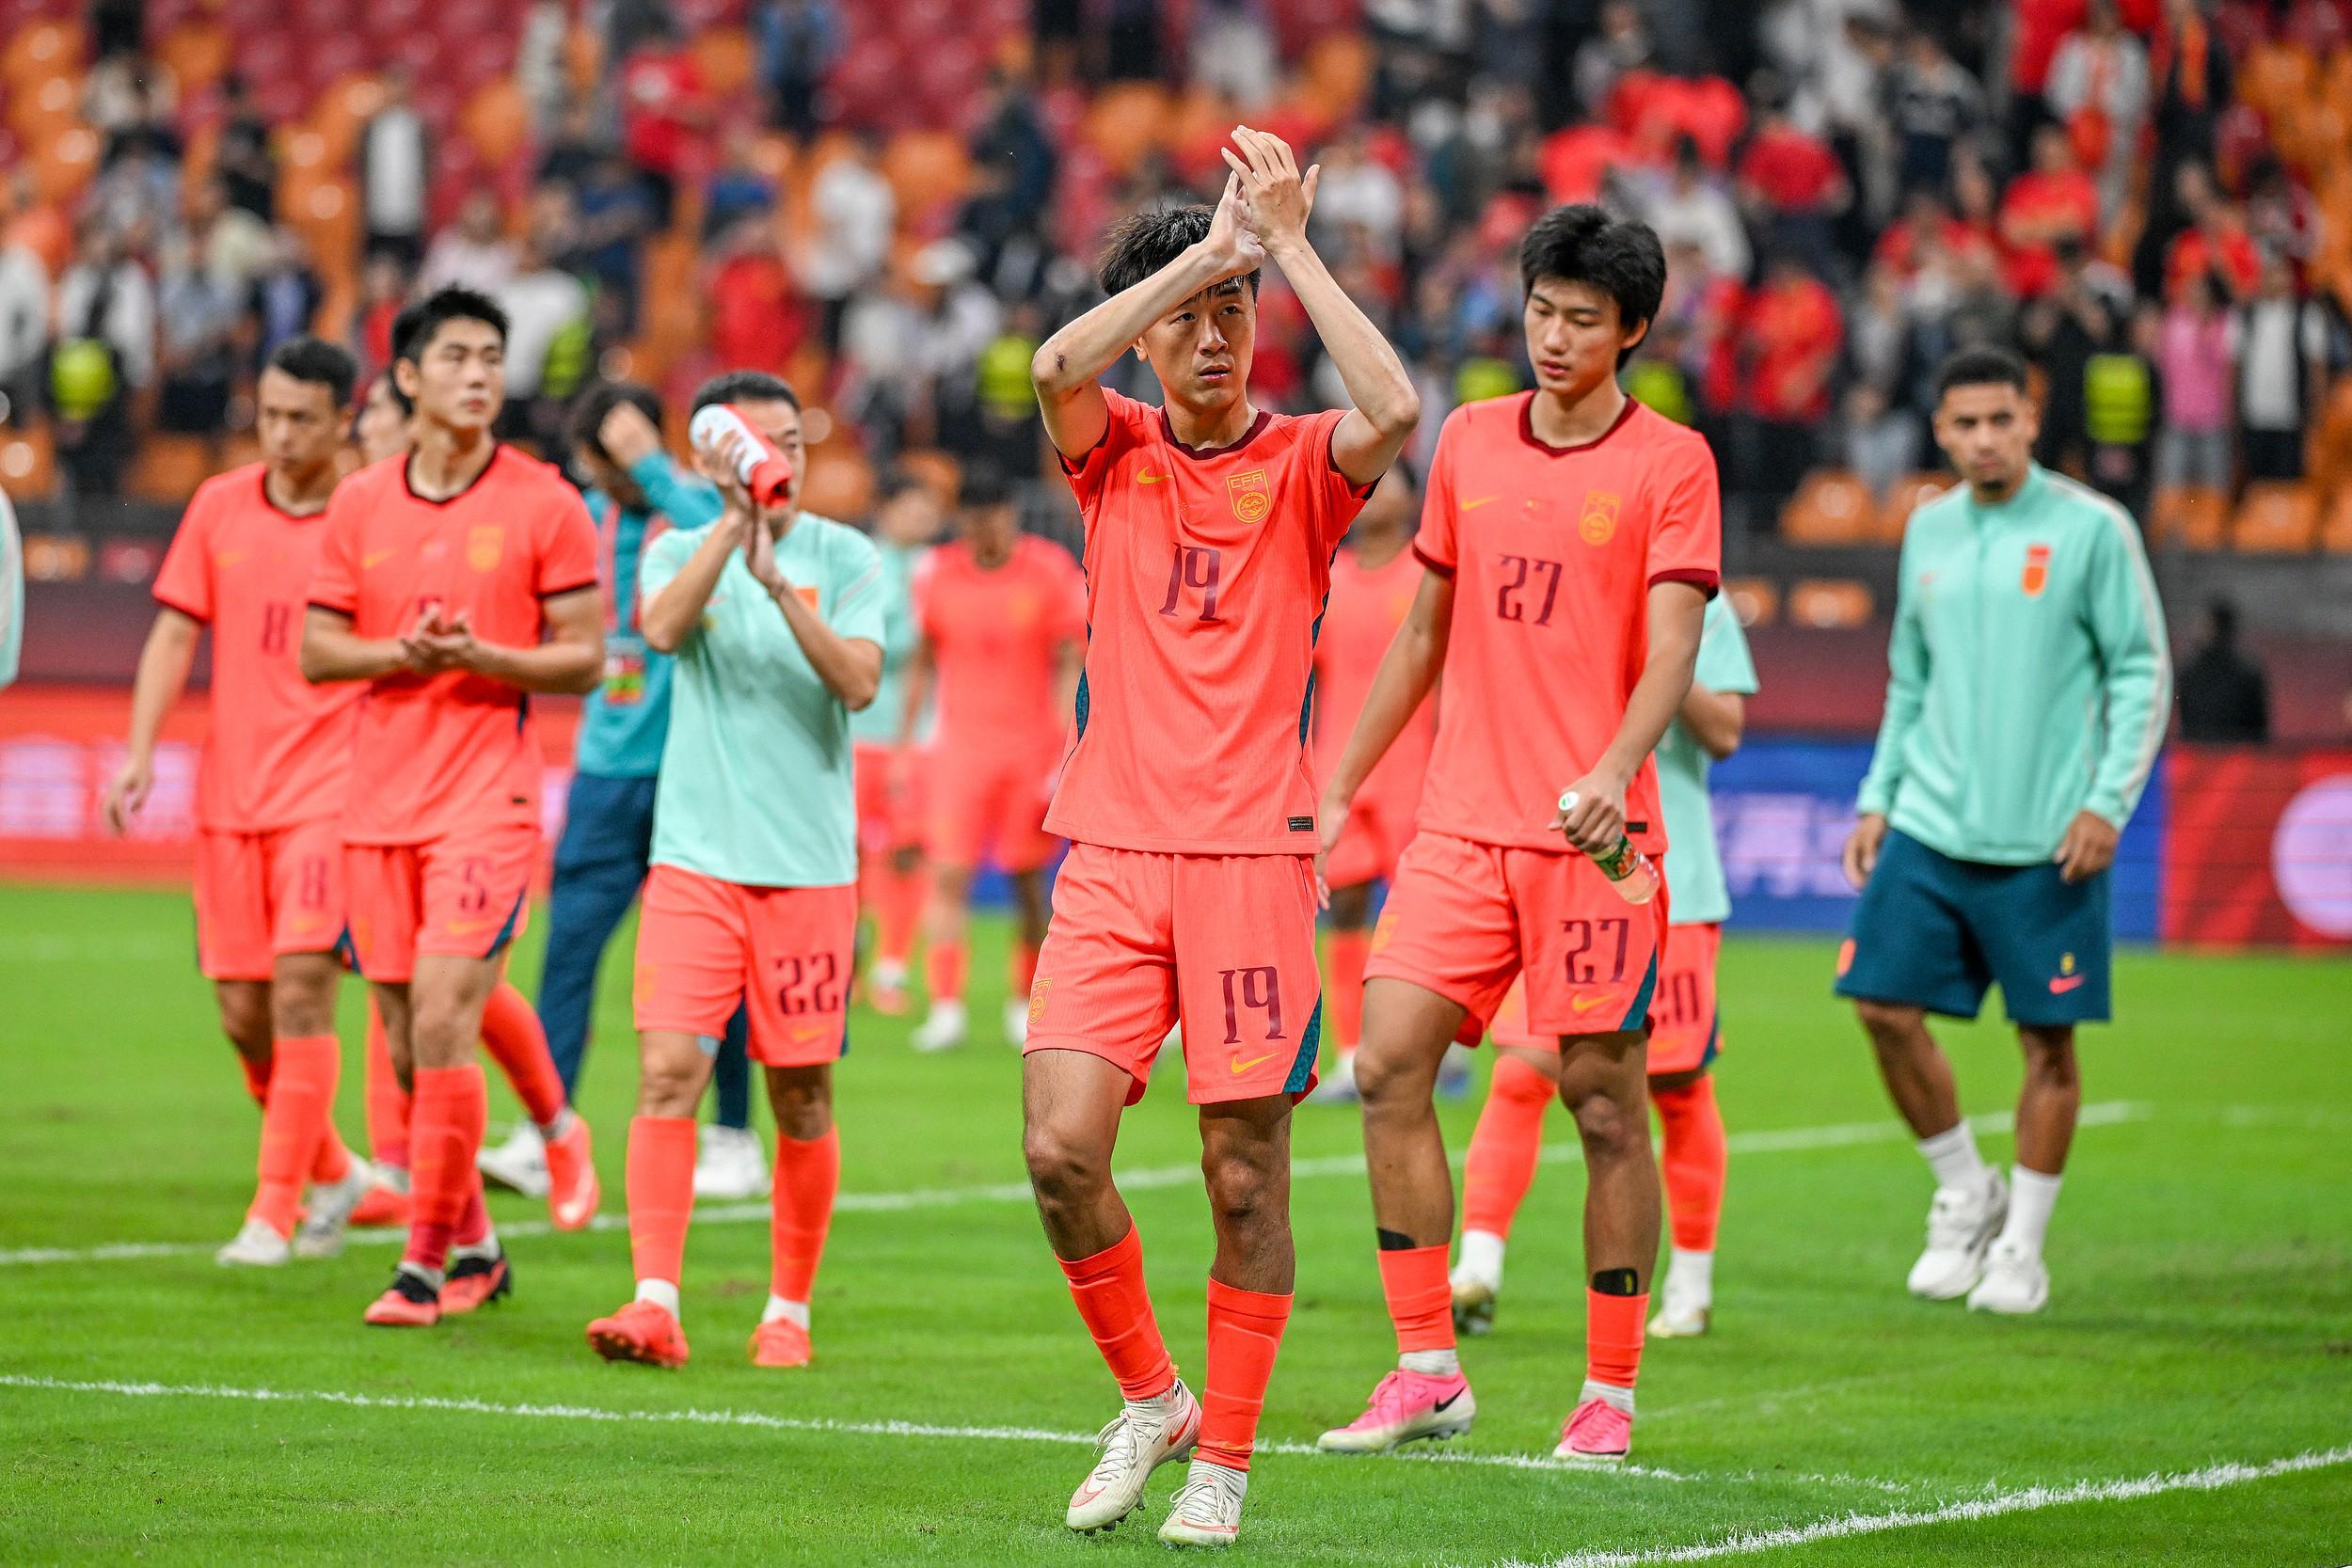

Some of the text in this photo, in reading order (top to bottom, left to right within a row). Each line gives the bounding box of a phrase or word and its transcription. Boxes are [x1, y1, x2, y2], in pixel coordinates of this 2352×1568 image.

[1231, 473, 1263, 488] CFA
[1158, 541, 1221, 622] 19
[1497, 553, 1563, 628] 27
[301, 857, 328, 911] 8
[458, 855, 490, 913] 5
[775, 952, 838, 1016] 22
[1560, 917, 1629, 985] 27
[1217, 965, 1288, 1045] 19
